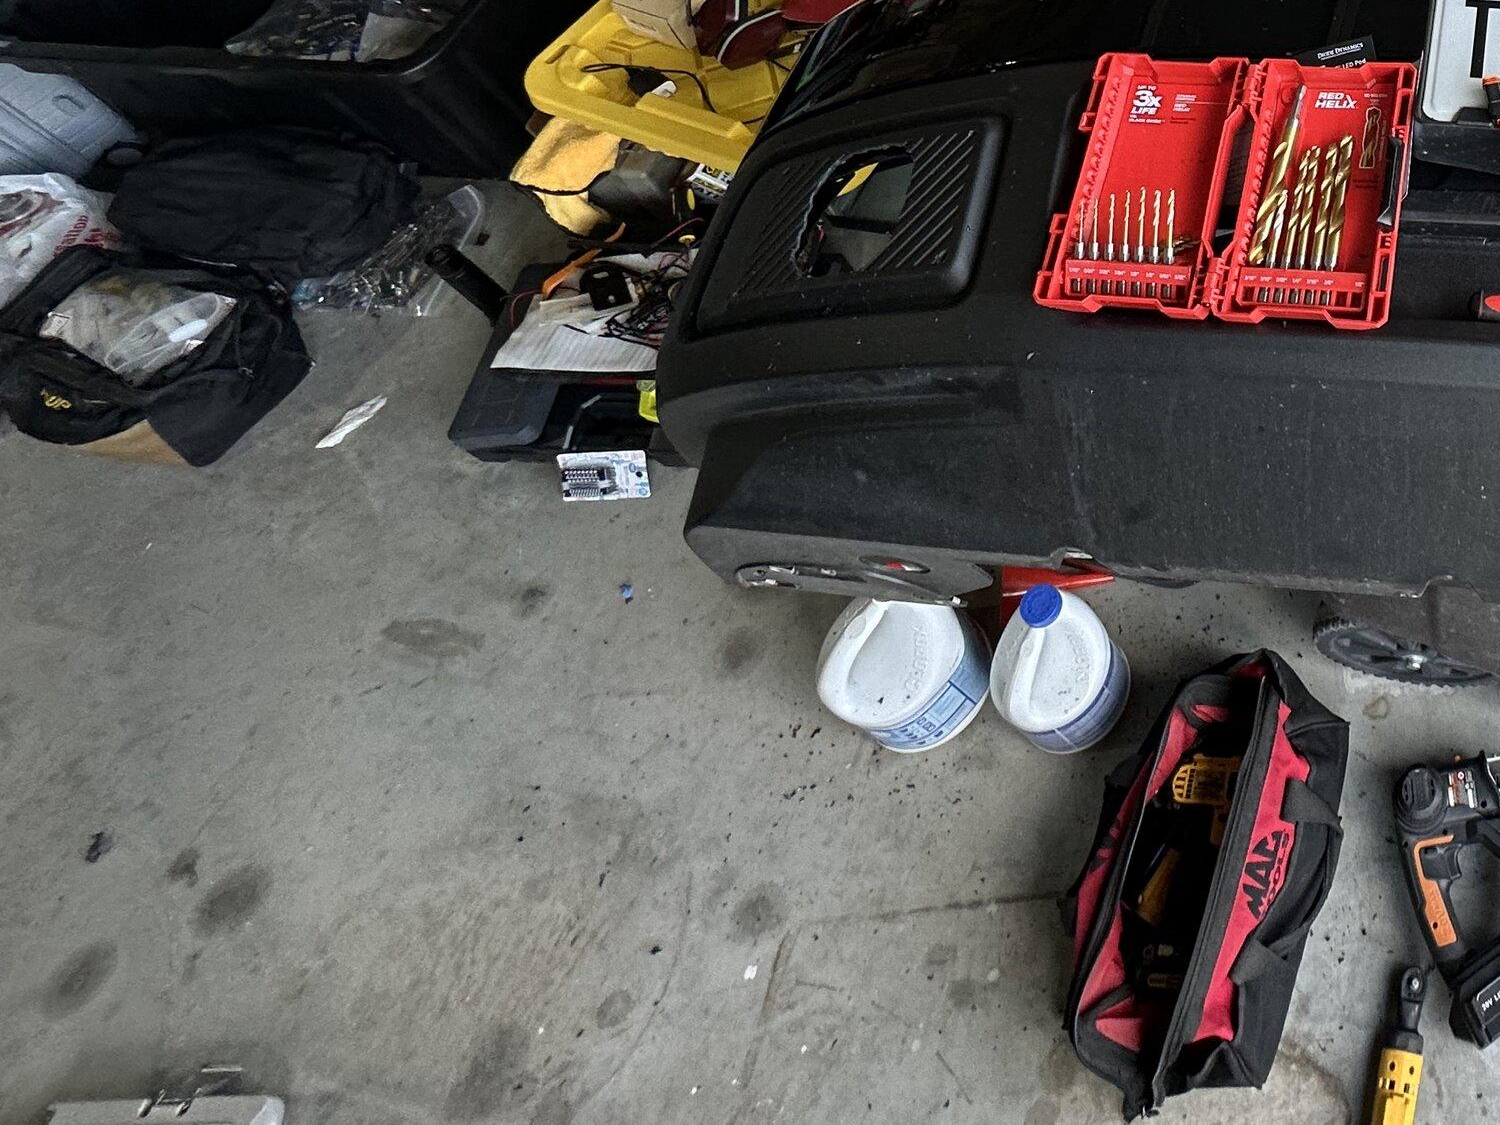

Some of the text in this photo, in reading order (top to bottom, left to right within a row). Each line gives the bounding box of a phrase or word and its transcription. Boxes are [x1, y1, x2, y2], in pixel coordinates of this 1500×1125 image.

[1354, 57, 1367, 66] Pod
[1317, 91, 1345, 100] RED
[1130, 106, 1158, 116] LIFE
[1243, 830, 1285, 919] MAC
